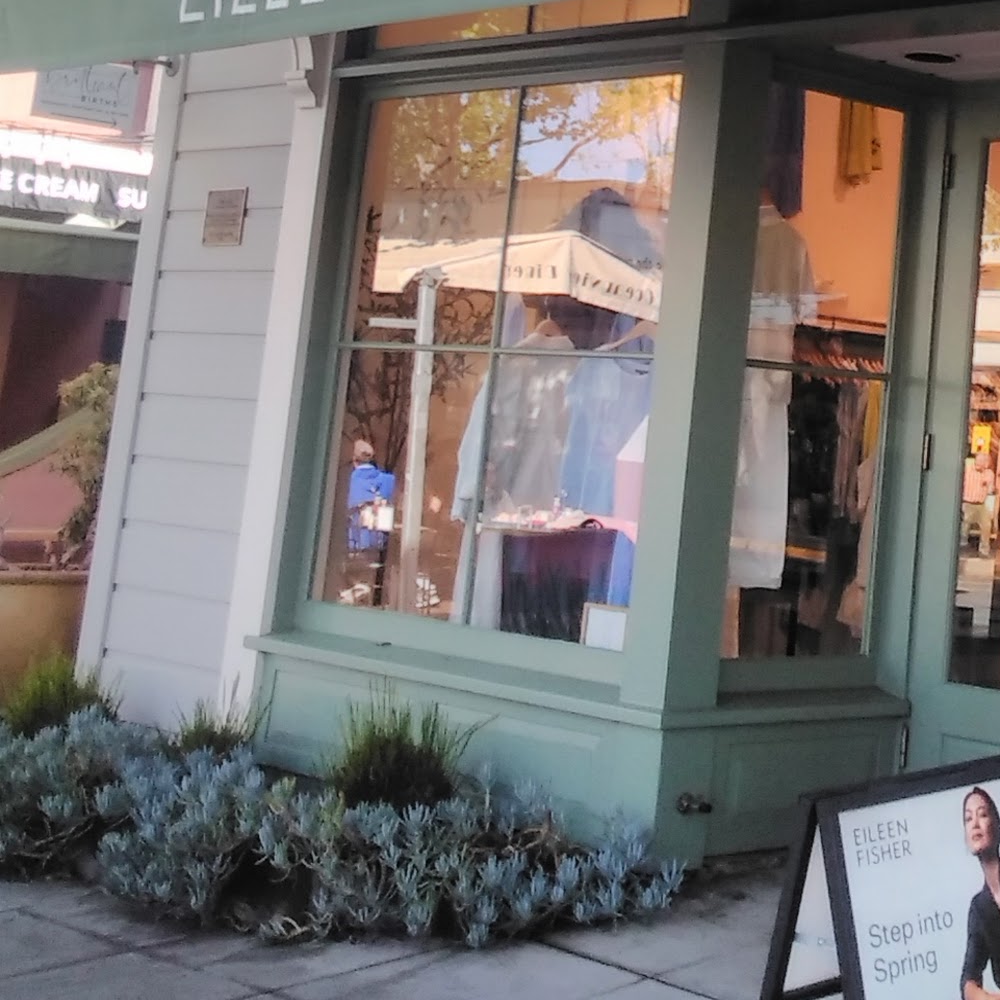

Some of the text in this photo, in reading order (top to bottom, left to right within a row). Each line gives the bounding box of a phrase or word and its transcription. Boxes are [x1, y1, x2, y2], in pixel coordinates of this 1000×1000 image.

[18, 174, 100, 203] CREAM
[853, 819, 909, 846] EILEEN
[856, 839, 912, 867] FISHER
[869, 911, 953, 948] Step into
[874, 950, 938, 983] Spring
